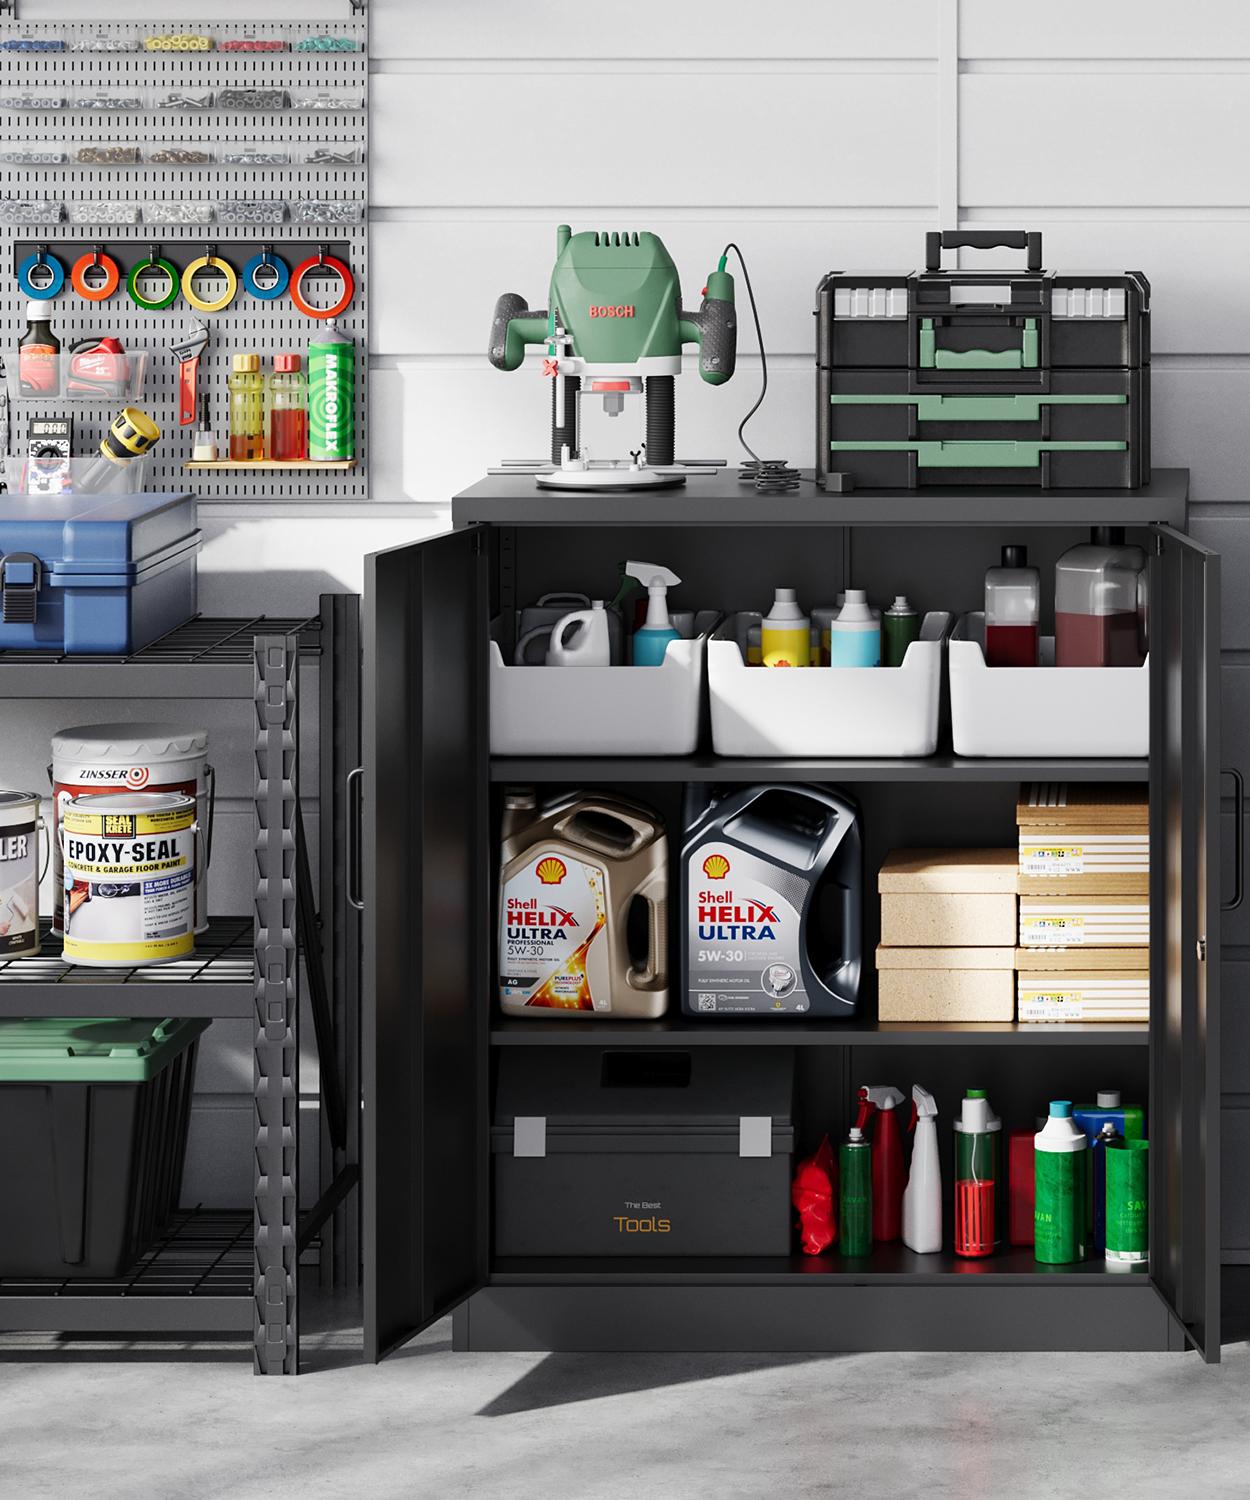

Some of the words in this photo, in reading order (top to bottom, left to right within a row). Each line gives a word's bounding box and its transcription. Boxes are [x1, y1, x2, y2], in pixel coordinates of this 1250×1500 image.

[589, 304, 635, 318] BOSCH
[325, 354, 338, 452] MAKROFLEX
[79, 769, 129, 779] ZINSSER
[105, 815, 132, 825] SEAL
[105, 825, 132, 834] KRETE
[69, 838, 180, 863] EPOXY-SEAL
[68, 861, 93, 872] CONCRETE
[136, 863, 159, 872] FLOOR
[161, 858, 181, 869] PAINT
[507, 898, 537, 909] Shell
[698, 891, 732, 903] Shell
[507, 910, 578, 926] HELIX
[698, 904, 780, 922] HELIX
[507, 927, 567, 940] ULTRA
[698, 925, 776, 940] ULTRA
[507, 945, 544, 955] 5W-30
[698, 950, 743, 961] 5W-30
[641, 1201, 661, 1209] Best
[613, 1216, 671, 1232] Tools
